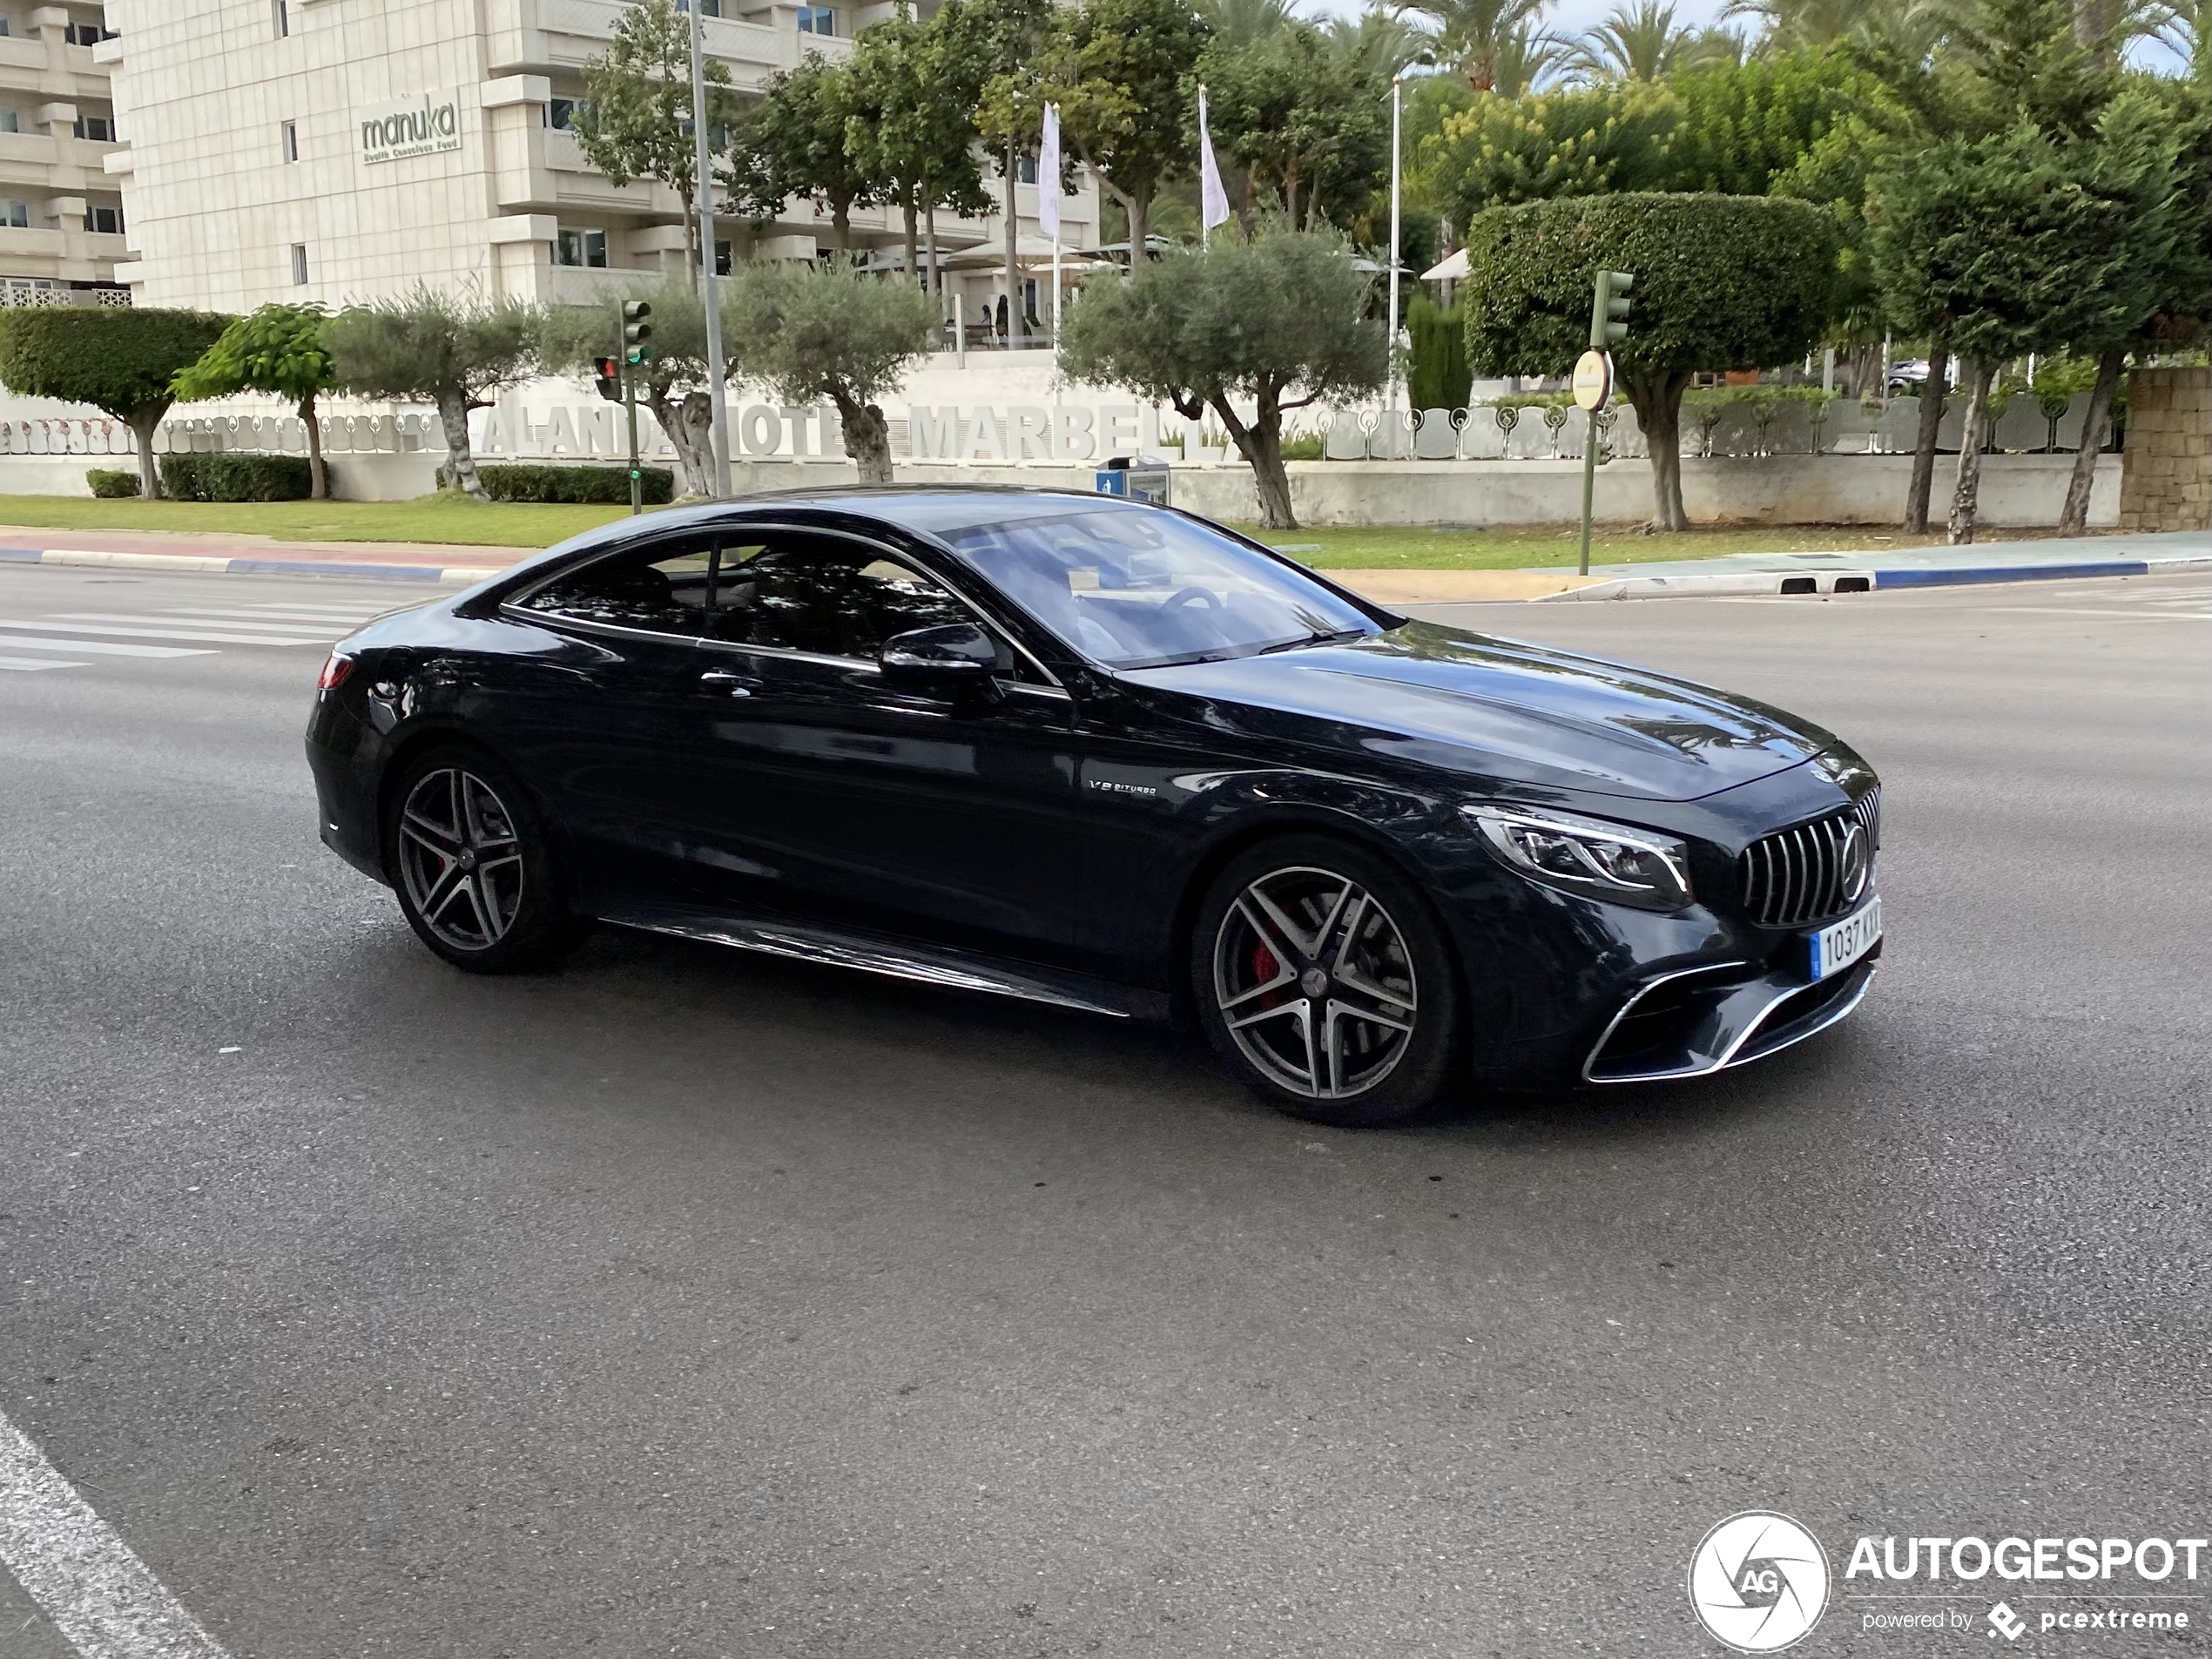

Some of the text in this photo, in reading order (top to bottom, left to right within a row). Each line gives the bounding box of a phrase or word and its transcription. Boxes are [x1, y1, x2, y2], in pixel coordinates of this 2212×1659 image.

[362, 93, 455, 149] manuka
[1089, 780, 1157, 795] V8 BITURBO
[1827, 919, 1860, 967] 1037
